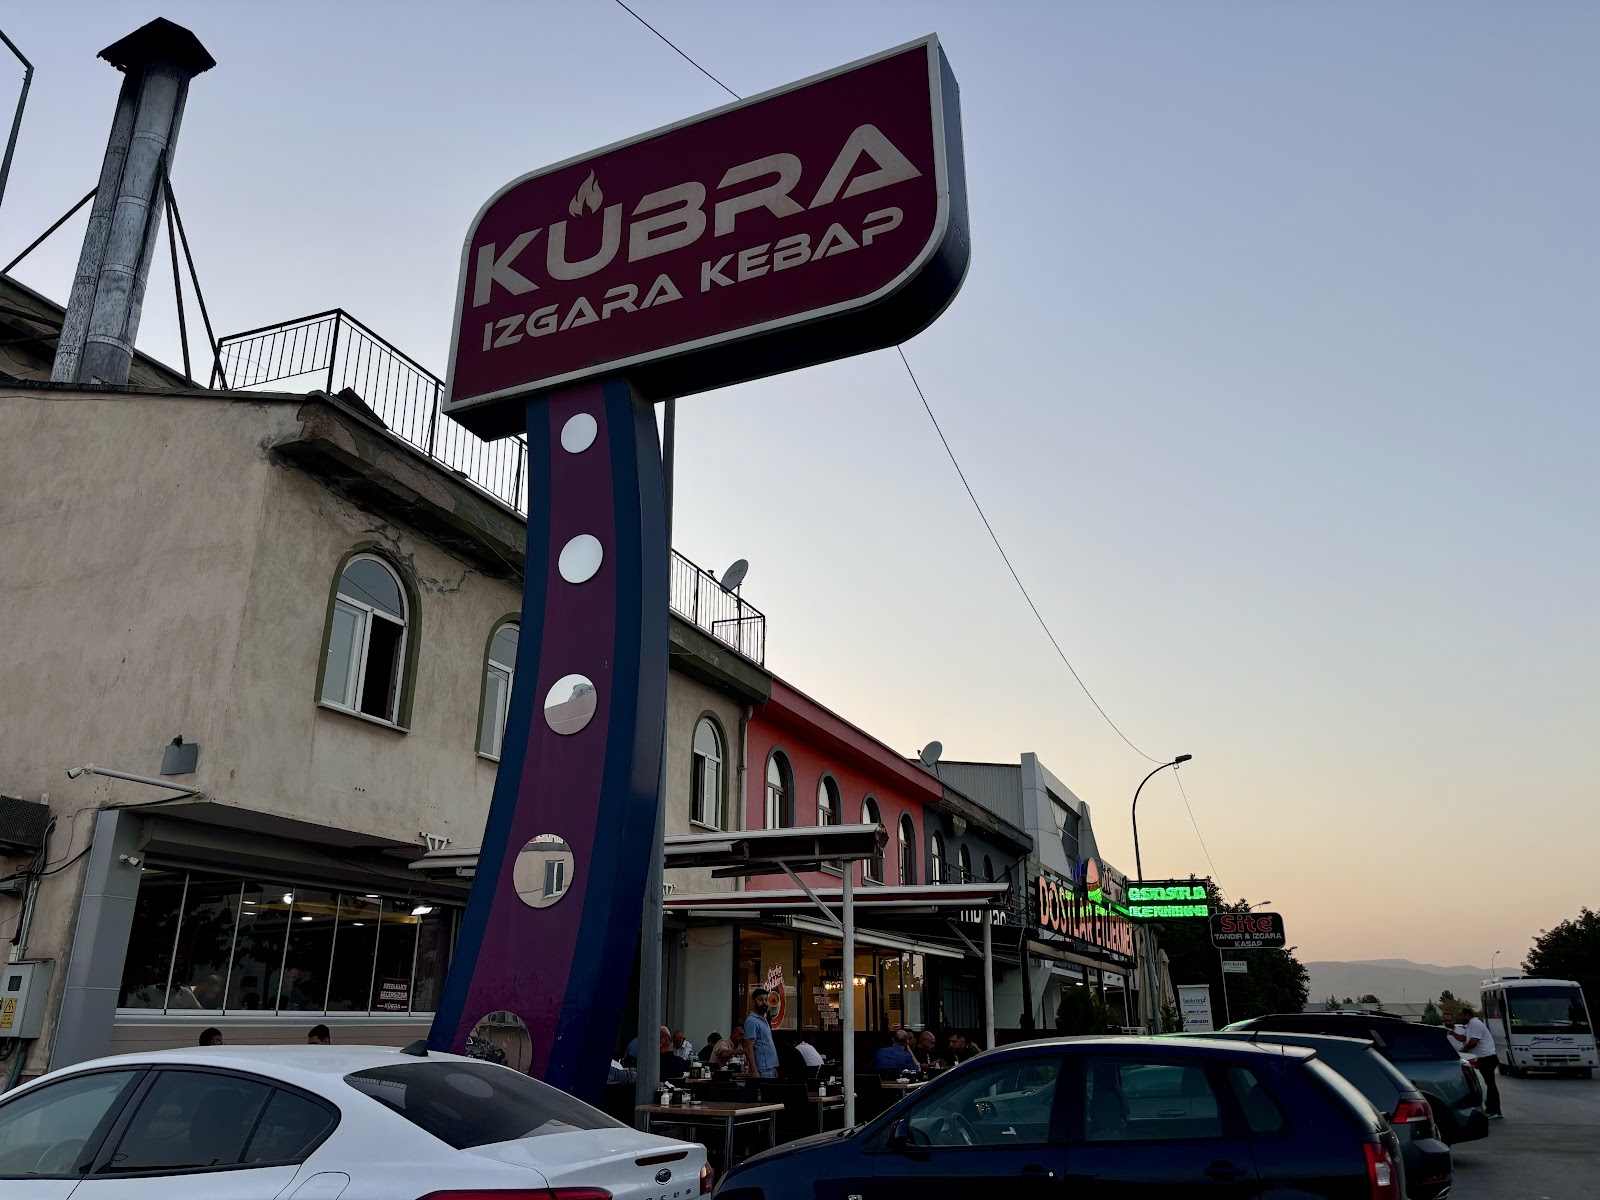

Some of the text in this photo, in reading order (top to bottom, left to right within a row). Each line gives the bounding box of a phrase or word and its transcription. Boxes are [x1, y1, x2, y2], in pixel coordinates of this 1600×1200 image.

[482, 206, 904, 352] IZGARA KEBAP
[1039, 876, 1094, 943] DOSTLAR
[1221, 915, 1273, 932] Site
